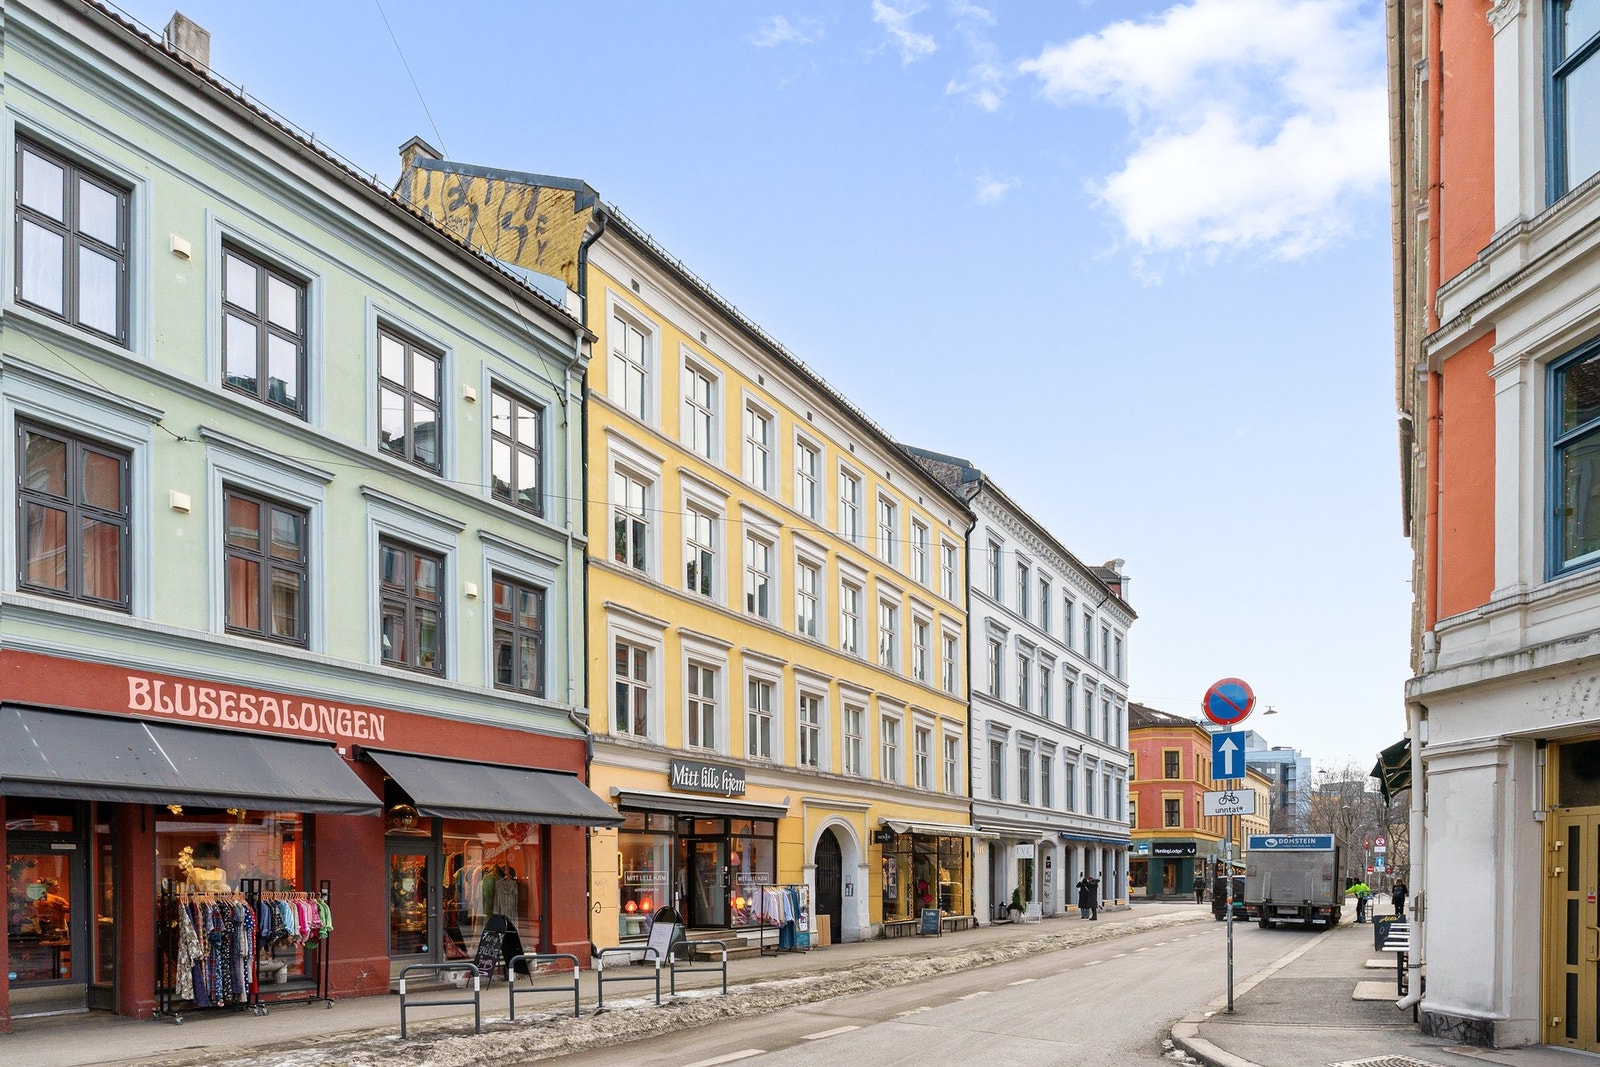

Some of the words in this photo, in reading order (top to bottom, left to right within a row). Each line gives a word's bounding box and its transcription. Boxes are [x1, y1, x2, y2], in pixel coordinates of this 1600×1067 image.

[127, 676, 386, 741] BLUSESALONGEN
[672, 763, 699, 787] Mitt
[701, 766, 720, 789] lille
[721, 769, 746, 797] hjem
[1215, 806, 1244, 814] unntat
